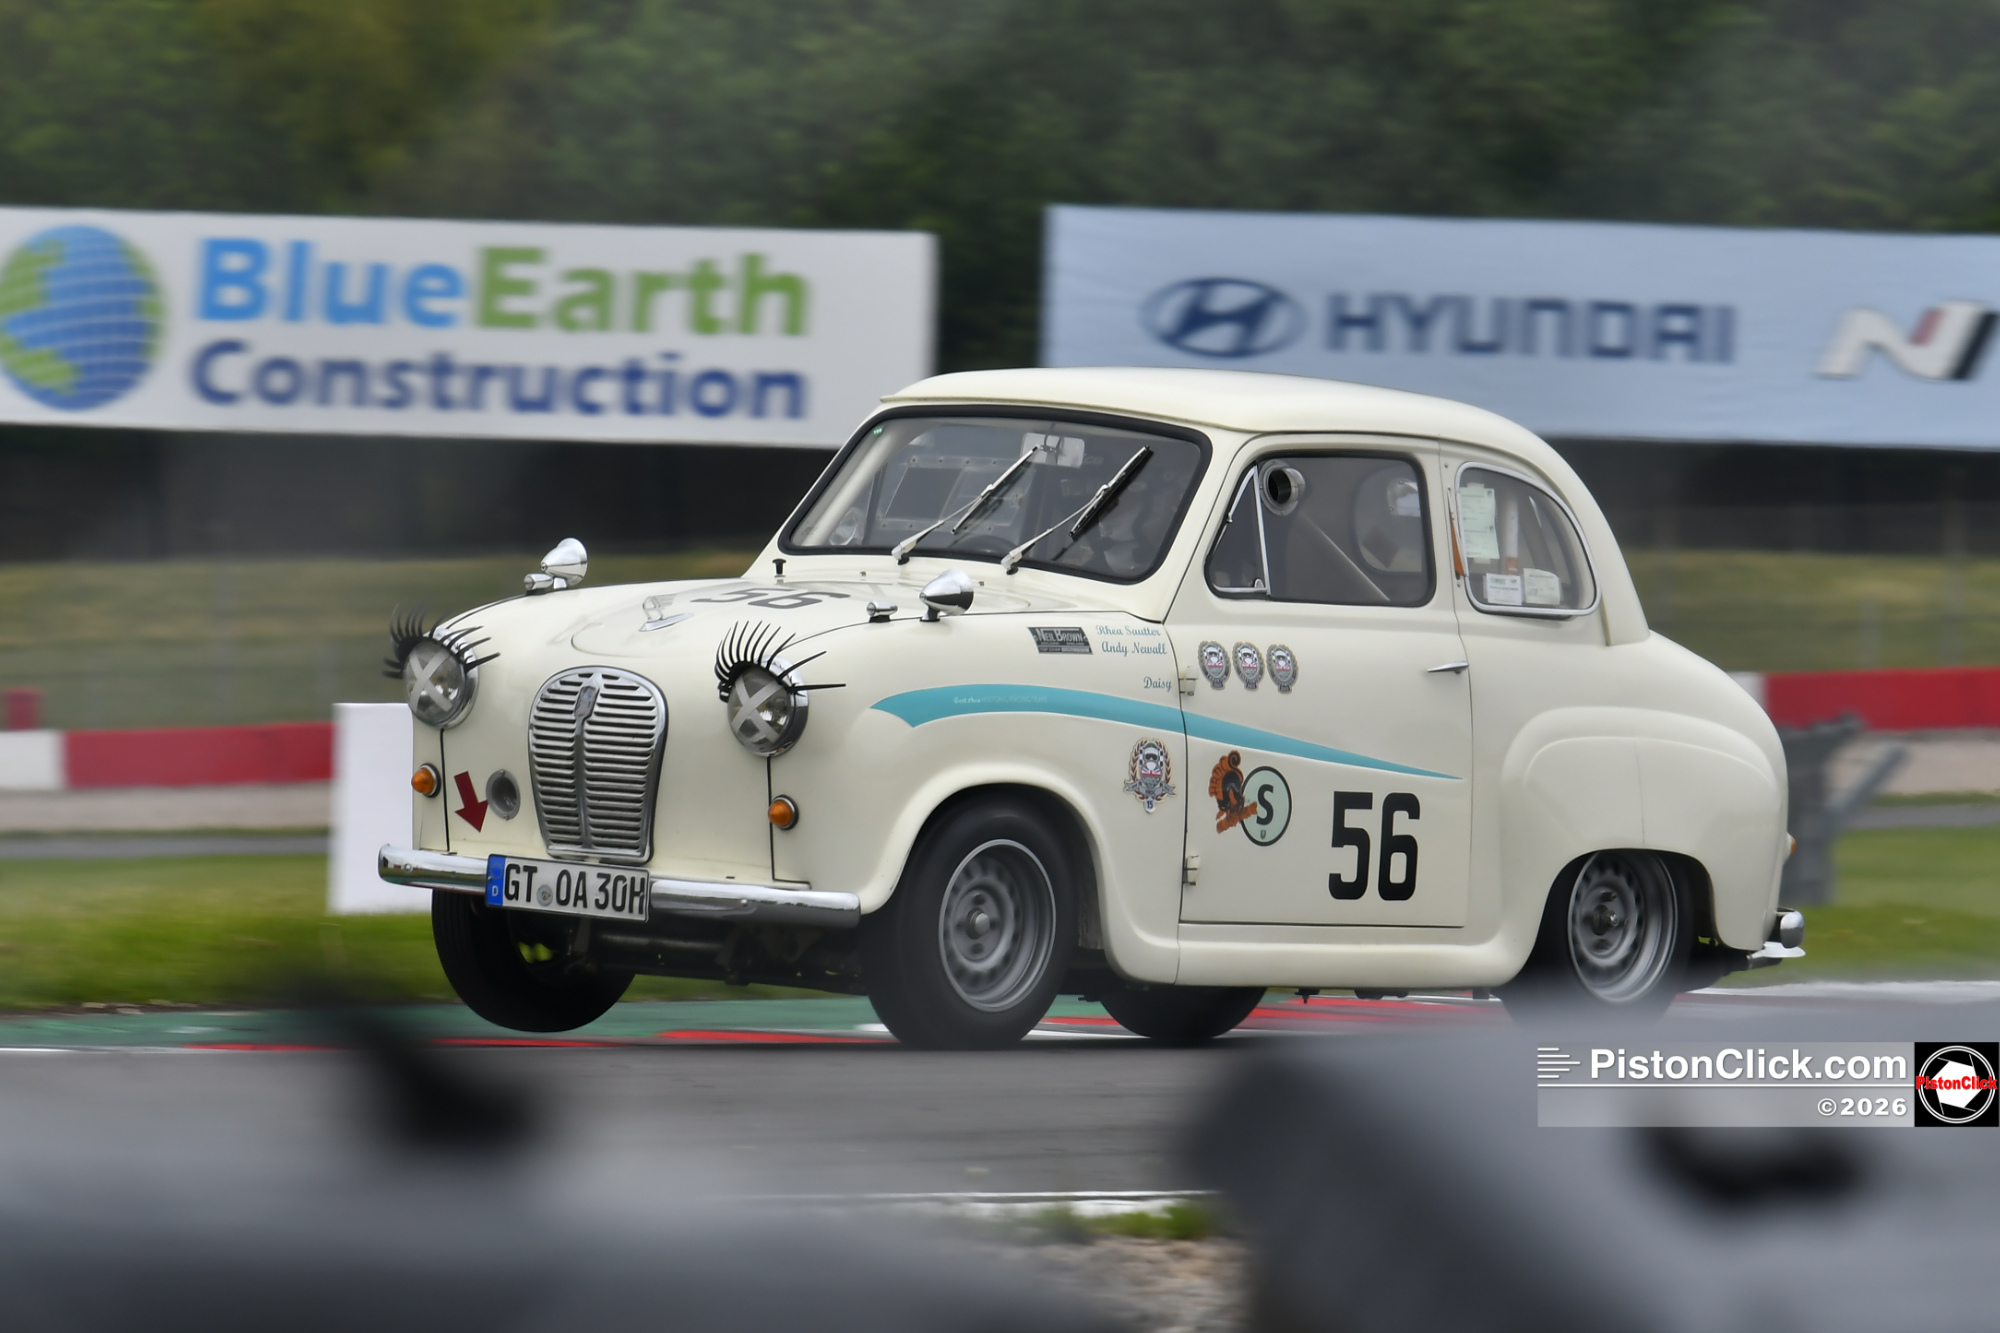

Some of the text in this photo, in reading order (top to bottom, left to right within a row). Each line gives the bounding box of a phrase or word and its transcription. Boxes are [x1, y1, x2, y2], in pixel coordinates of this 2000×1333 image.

[196, 238, 812, 336] BlueEarth
[1324, 293, 1738, 364] HYUNDAI
[189, 338, 808, 420] Construction
[690, 588, 851, 609] 56
[1035, 628, 1084, 642] NEIL BROWN
[1096, 625, 1123, 636] Rhea
[1101, 641, 1128, 657] Andy
[1131, 642, 1167, 655] Newall
[1143, 676, 1172, 692] Daisy
[1146, 800, 1154, 809] 15
[1256, 784, 1274, 826] S
[1328, 791, 1420, 901] 56
[491, 885, 499, 897] D
[504, 863, 538, 903] GT
